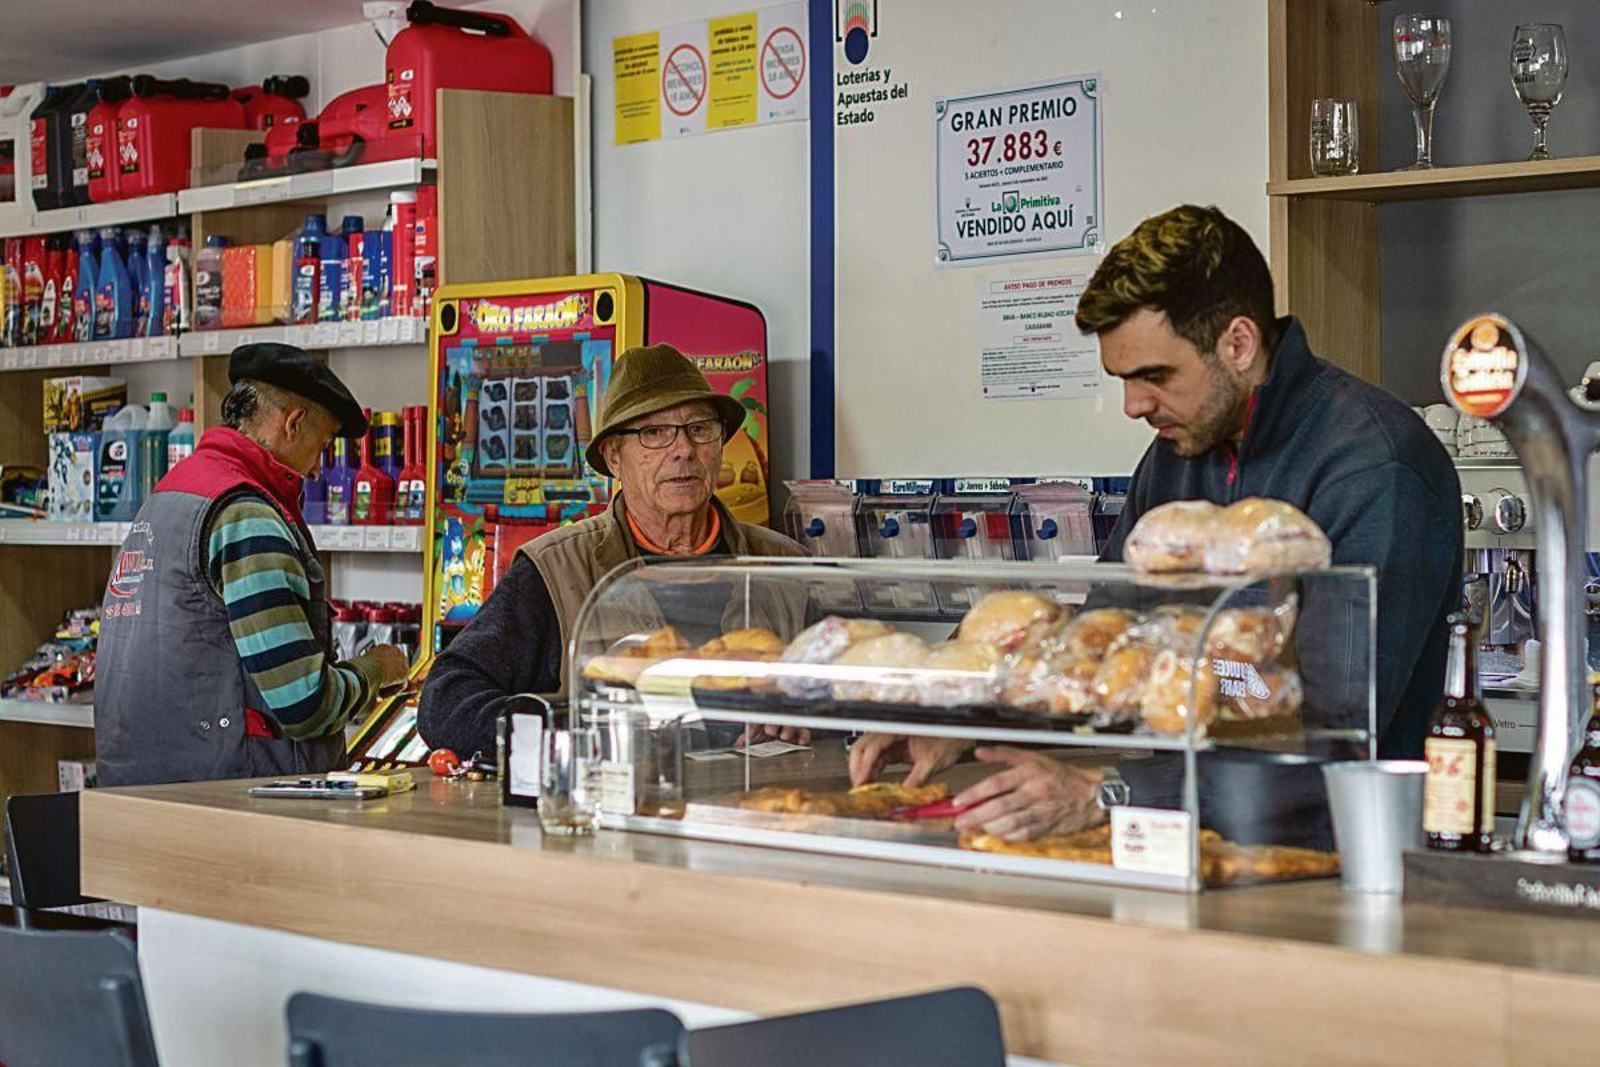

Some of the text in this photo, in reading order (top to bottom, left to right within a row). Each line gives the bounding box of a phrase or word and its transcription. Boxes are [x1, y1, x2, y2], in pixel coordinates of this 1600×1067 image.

[765, 55, 801, 70] MENRES
[667, 74, 703, 88] MENRES
[836, 66, 891, 86] Loterías y
[837, 83, 908, 107] Apuestas del
[836, 108, 875, 126] Estado
[950, 96, 1078, 133] GRAN PREMIO
[966, 128, 1049, 167] 37.883
[969, 167, 999, 181] ACIERTOS
[1004, 160, 1064, 177] COMPLEMENTARIO
[991, 201, 1002, 213] La
[1020, 194, 1061, 210] Primitiva
[956, 203, 1074, 239] VENDIDO AQUÍ
[1003, 278, 1073, 291] AVISO PAGO DE PREMIOS
